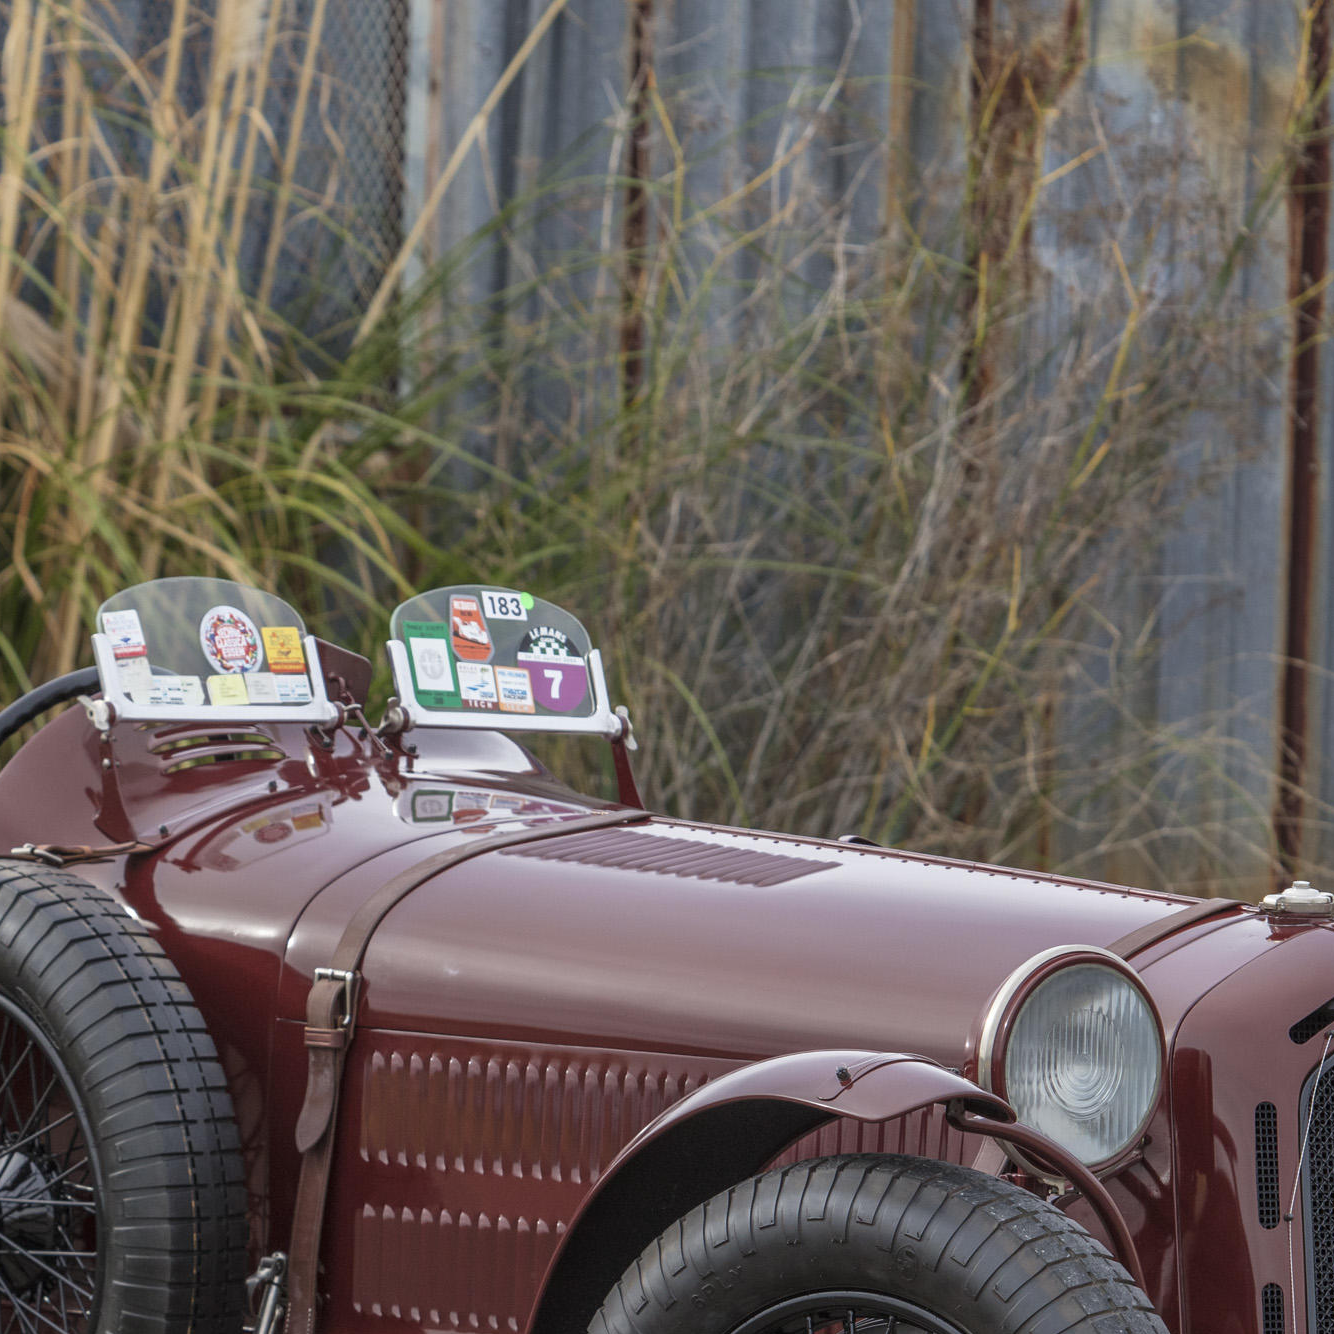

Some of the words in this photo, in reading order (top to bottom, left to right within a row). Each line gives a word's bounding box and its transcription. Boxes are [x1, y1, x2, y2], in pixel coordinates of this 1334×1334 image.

[488, 596, 522, 617] 183
[543, 669, 563, 699] 7
[468, 699, 493, 709] TECH
